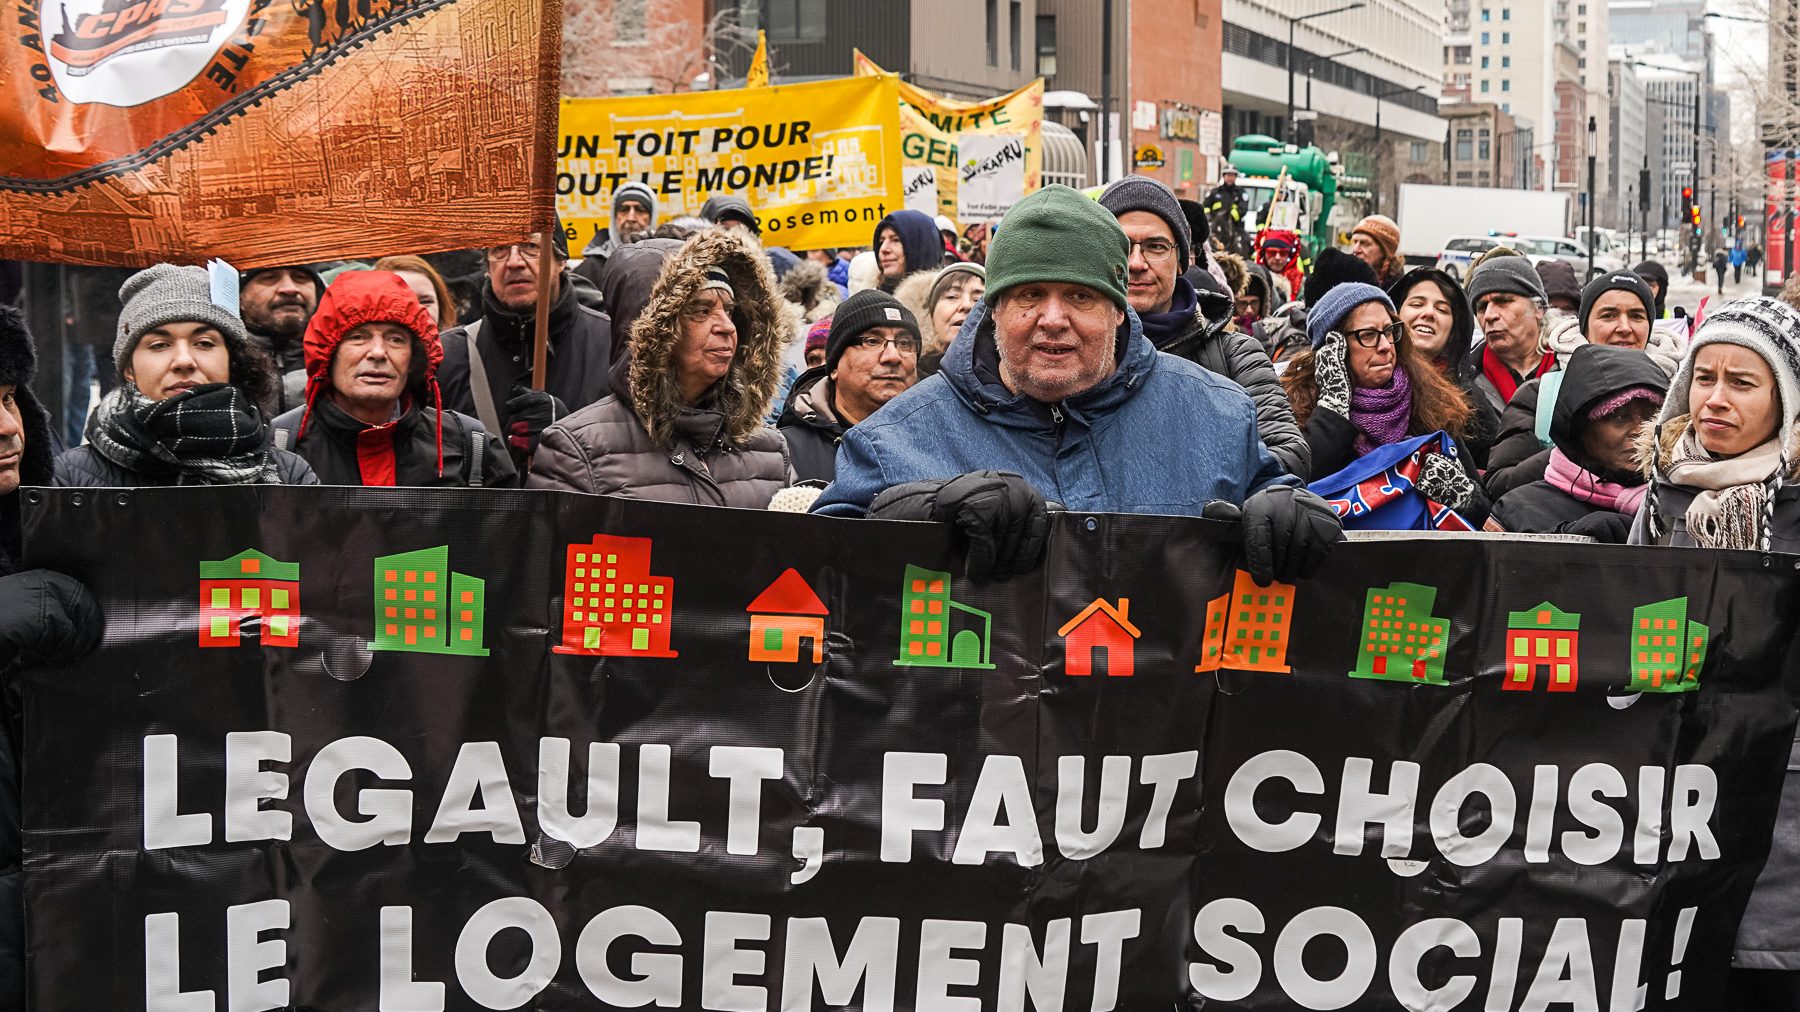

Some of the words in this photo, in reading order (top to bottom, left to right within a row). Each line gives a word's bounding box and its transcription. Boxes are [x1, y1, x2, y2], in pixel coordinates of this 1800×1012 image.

[30, 64, 58, 103] 40
[613, 130, 700, 157] TOIT
[711, 120, 811, 152] POUR
[695, 154, 834, 192] MONDE!
[144, 731, 824, 884] LEGAULT,
[880, 751, 1198, 866] FAUT
[1225, 750, 1721, 867] CHOISIR
[146, 899, 291, 1012] LE
[379, 897, 1141, 1012] LOGEMENT
